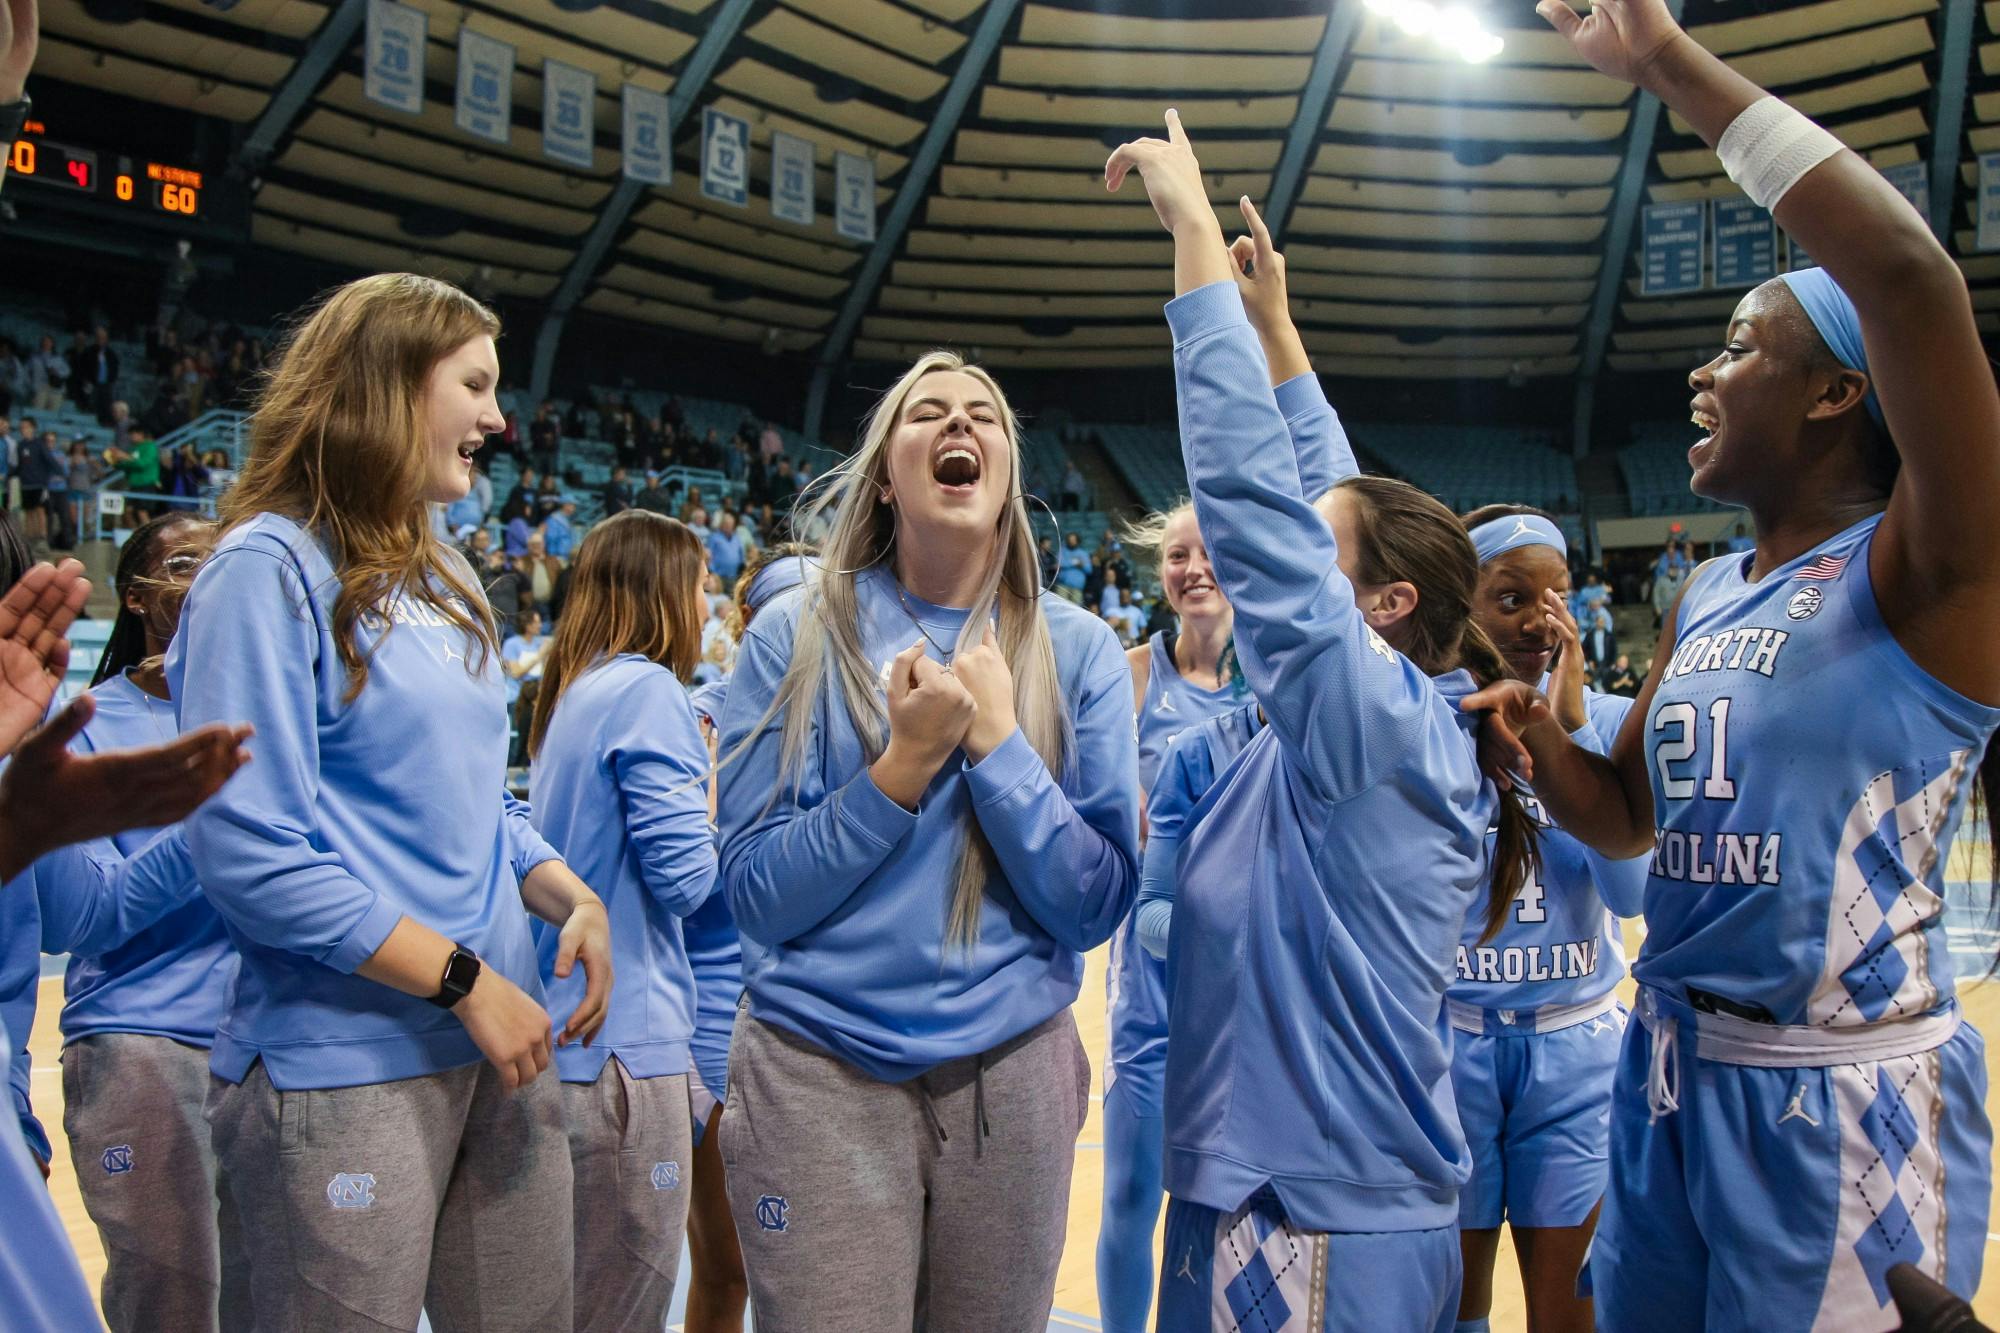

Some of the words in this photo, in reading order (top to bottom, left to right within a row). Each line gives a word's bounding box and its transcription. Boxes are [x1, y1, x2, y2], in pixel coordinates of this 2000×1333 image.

[67, 160, 88, 187] 4
[116, 174, 134, 201] 0
[163, 183, 196, 214] 60
[1653, 696, 1736, 800] 21
